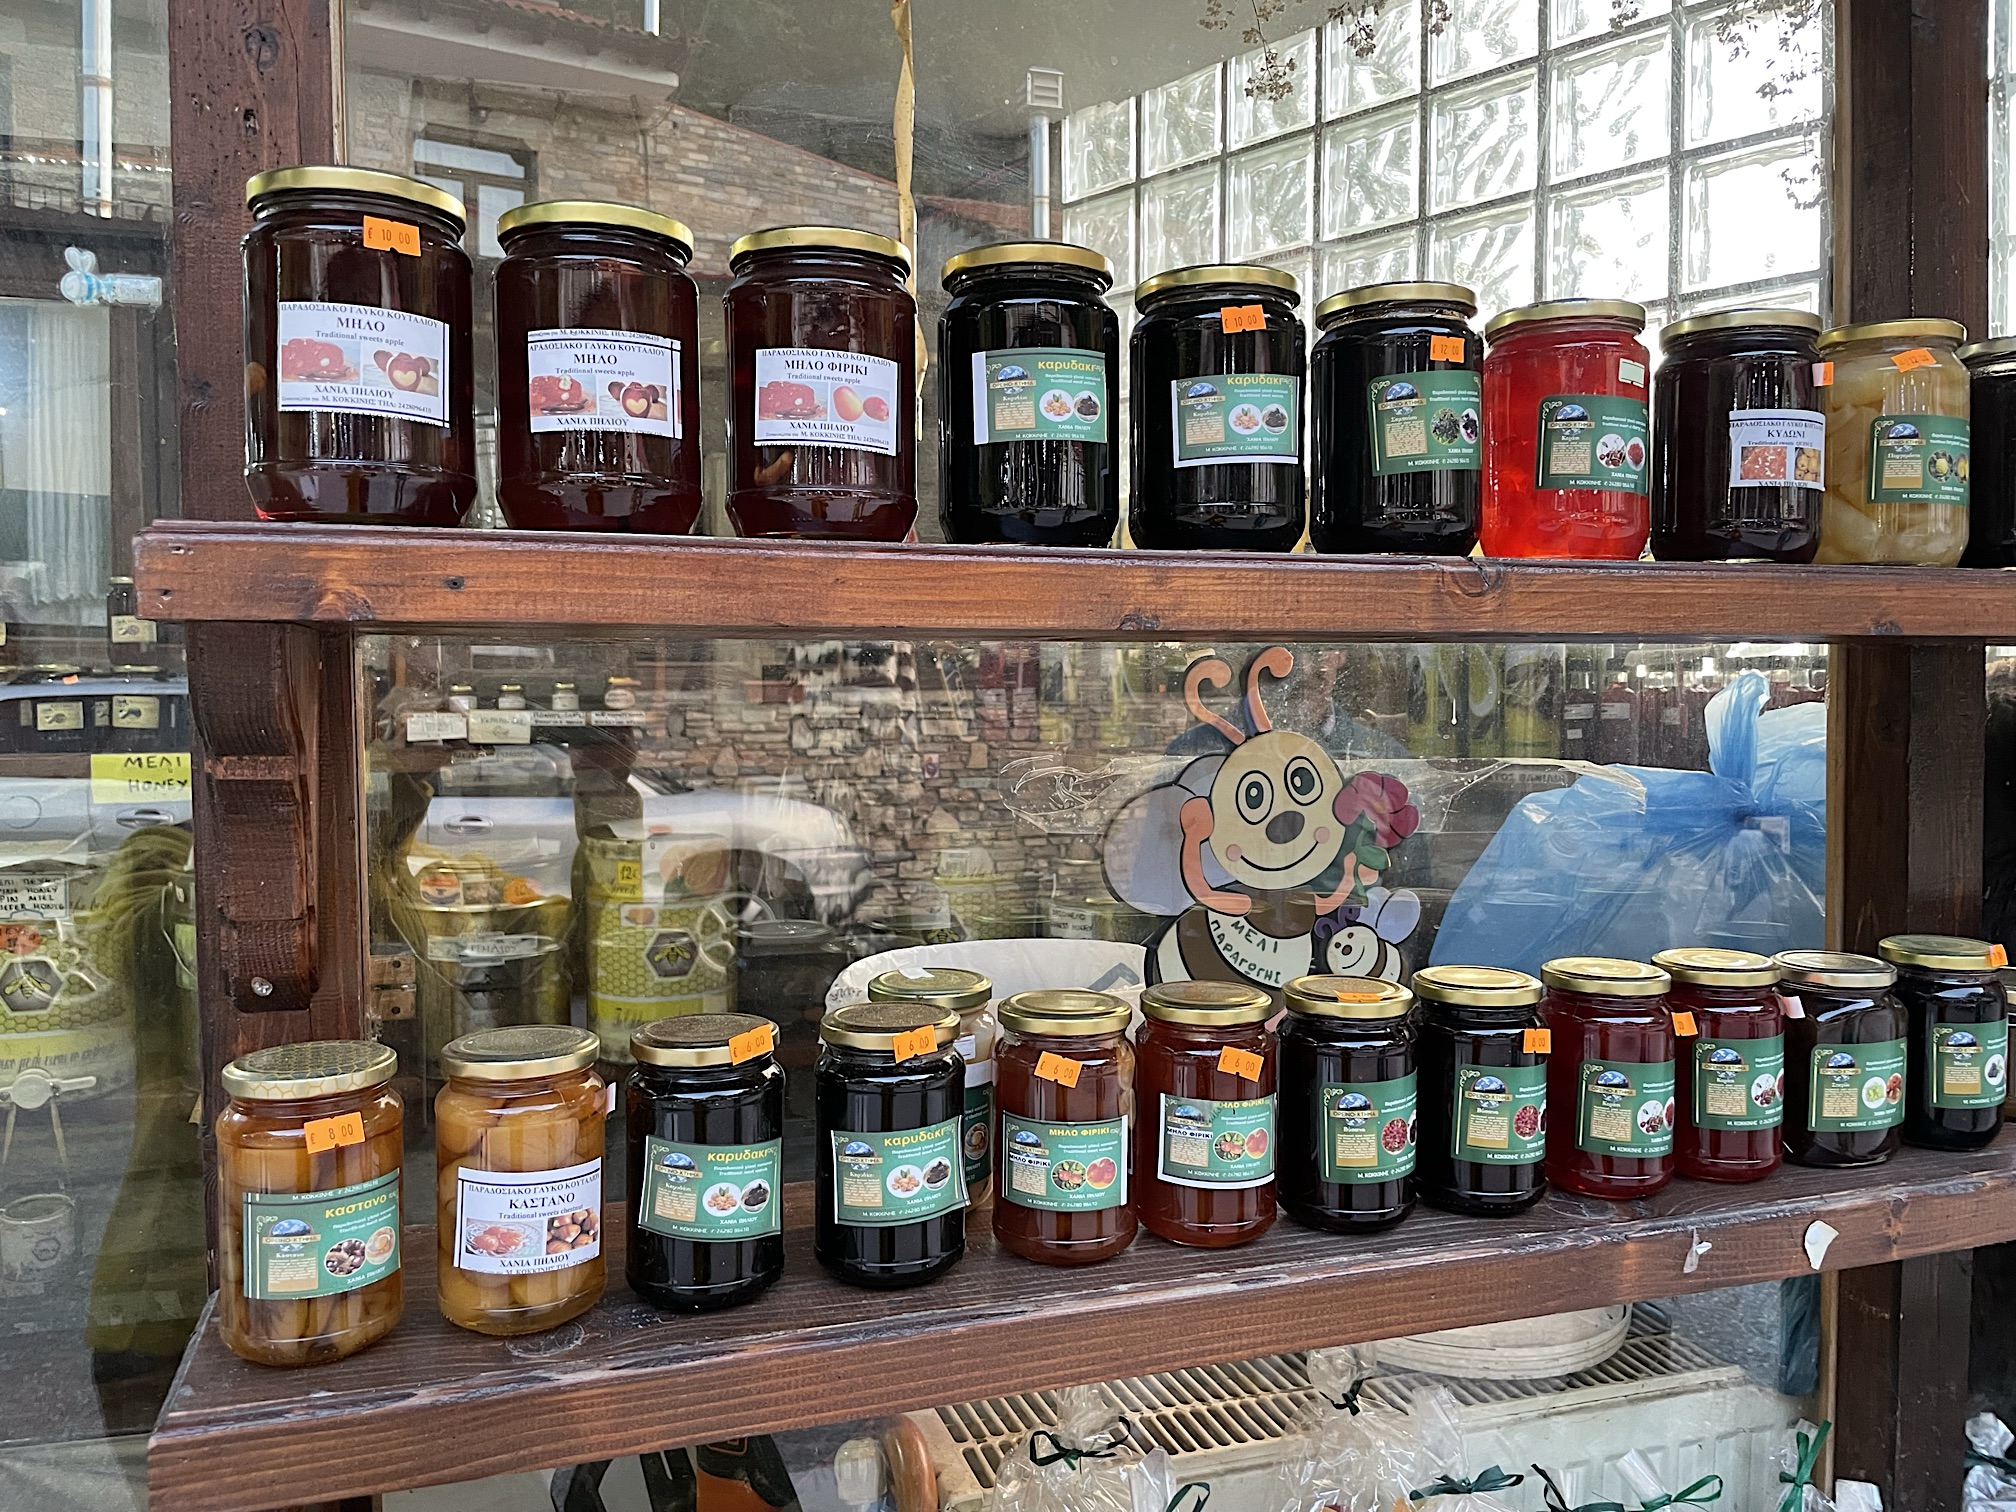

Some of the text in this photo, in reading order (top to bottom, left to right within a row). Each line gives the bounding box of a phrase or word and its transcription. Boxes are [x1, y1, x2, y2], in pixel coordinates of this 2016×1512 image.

[381, 228, 392, 242] 10
[399, 233, 411, 245] 00
[281, 304, 439, 328] ΠΑΡΑΔΟΣΙΑΚΟ ΓΛΥΚΟ ΚΟΥΤΑΛΙΟΥ
[1235, 317, 1243, 327] 10
[1248, 314, 1257, 325] 00
[337, 317, 385, 332] ΜΗΛΟ
[316, 331, 405, 346] Traditional sweets apple
[529, 342, 583, 351] ΑΡΑΔΟΣΙΑΚΟ
[618, 344, 665, 356] ΚΟΥΤΑΛΙΟΥ
[574, 355, 617, 364] ΜΗΛΟ
[820, 351, 849, 359] ΓΛΥΚΟ
[851, 354, 891, 367] ΚΟΥΤΑΛΙΟΥ
[1038, 360, 1095, 372] καρυδακι
[784, 360, 868, 375] ΜΗΛΟ ΦΙΡΙΚΙ
[844, 377, 861, 385] apple
[1227, 375, 1282, 386] καρυδακι
[314, 385, 395, 399] ΧΑΝΙΑ ΠΗΛΙΟΥ
[332, 396, 376, 406] ΚΟΚΚΙΝΗΣ
[590, 418, 629, 426] ΠΗΛΙΟΥ
[790, 422, 855, 432] ΧΑΝΙΑ ΠΗΛΙΟΥ
[1767, 429, 1805, 438] ΚΥΔΩΝΙ
[124, 755, 182, 769] ΜΕΛΙ
[128, 778, 188, 793] HONEY
[1231, 920, 1278, 954] ΜΕΛΙ
[747, 1041, 752, 1052] 6
[756, 1035, 765, 1047] 00
[909, 1039, 914, 1051] 6
[1054, 1064, 1059, 1075] 6
[1063, 1068, 1074, 1079] 00
[1235, 1058, 1240, 1068] 6
[1245, 1061, 1255, 1072] 00
[329, 1128, 335, 1140] 8
[341, 1123, 354, 1137] 00
[884, 1129, 945, 1148] καρυδακι
[1049, 1127, 1110, 1137] ΜΗΛΟ ΦΙΡΙΚΙ
[1167, 1127, 1213, 1139] ΜΗΛΟ ΦΙΡΙΚΙ
[707, 1149, 768, 1163] καρυδακι
[1010, 1153, 1051, 1167] ΜΗΛΟ ΦΙΡΙΚΙ
[468, 1184, 532, 1195] ΠΑΡΑΔΟΣΙΑΚΟ
[534, 1183, 564, 1194] ΓΛΥΚΟ
[325, 1195, 387, 1219] καστανο
[509, 1192, 575, 1209] ΚΑΣΤΑΝΟ
[538, 1210, 560, 1218] sweets
[499, 1259, 531, 1268] ΧΑΝΙΑ
[533, 1253, 572, 1266] ΠΗΛΙΟΥ
